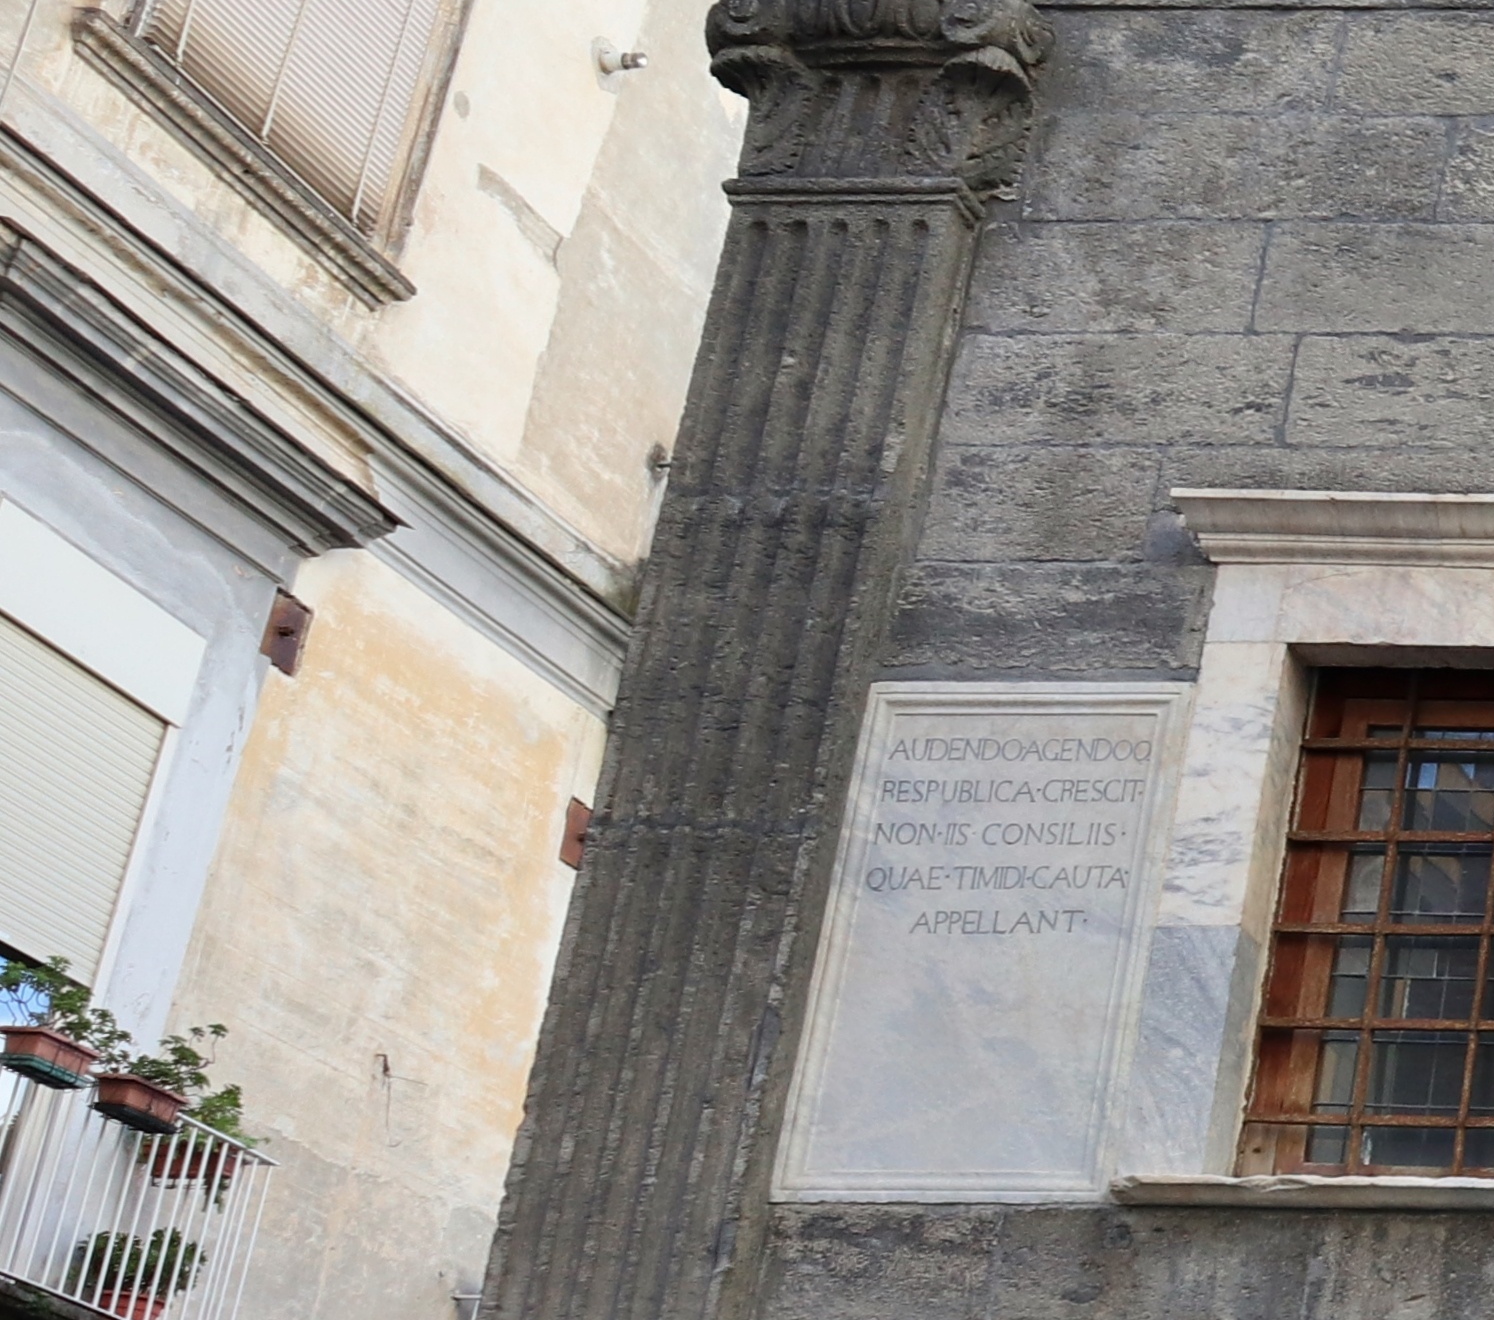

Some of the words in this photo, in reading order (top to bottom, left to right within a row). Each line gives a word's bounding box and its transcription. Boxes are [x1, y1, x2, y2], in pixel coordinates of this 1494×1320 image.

[888, 738, 1023, 762] AUDENDO
[880, 779, 1036, 803] RESPUBLICA
[1042, 779, 1145, 803] CRESCIT
[873, 822, 937, 846] NON
[943, 822, 971, 845] IIS
[981, 822, 1117, 846] CONSILIIS
[866, 866, 944, 892] QUAE
[954, 866, 1027, 890] TIMIDI
[1030, 865, 1128, 889] CAUTA
[908, 910, 1086, 934] APPELLANT
